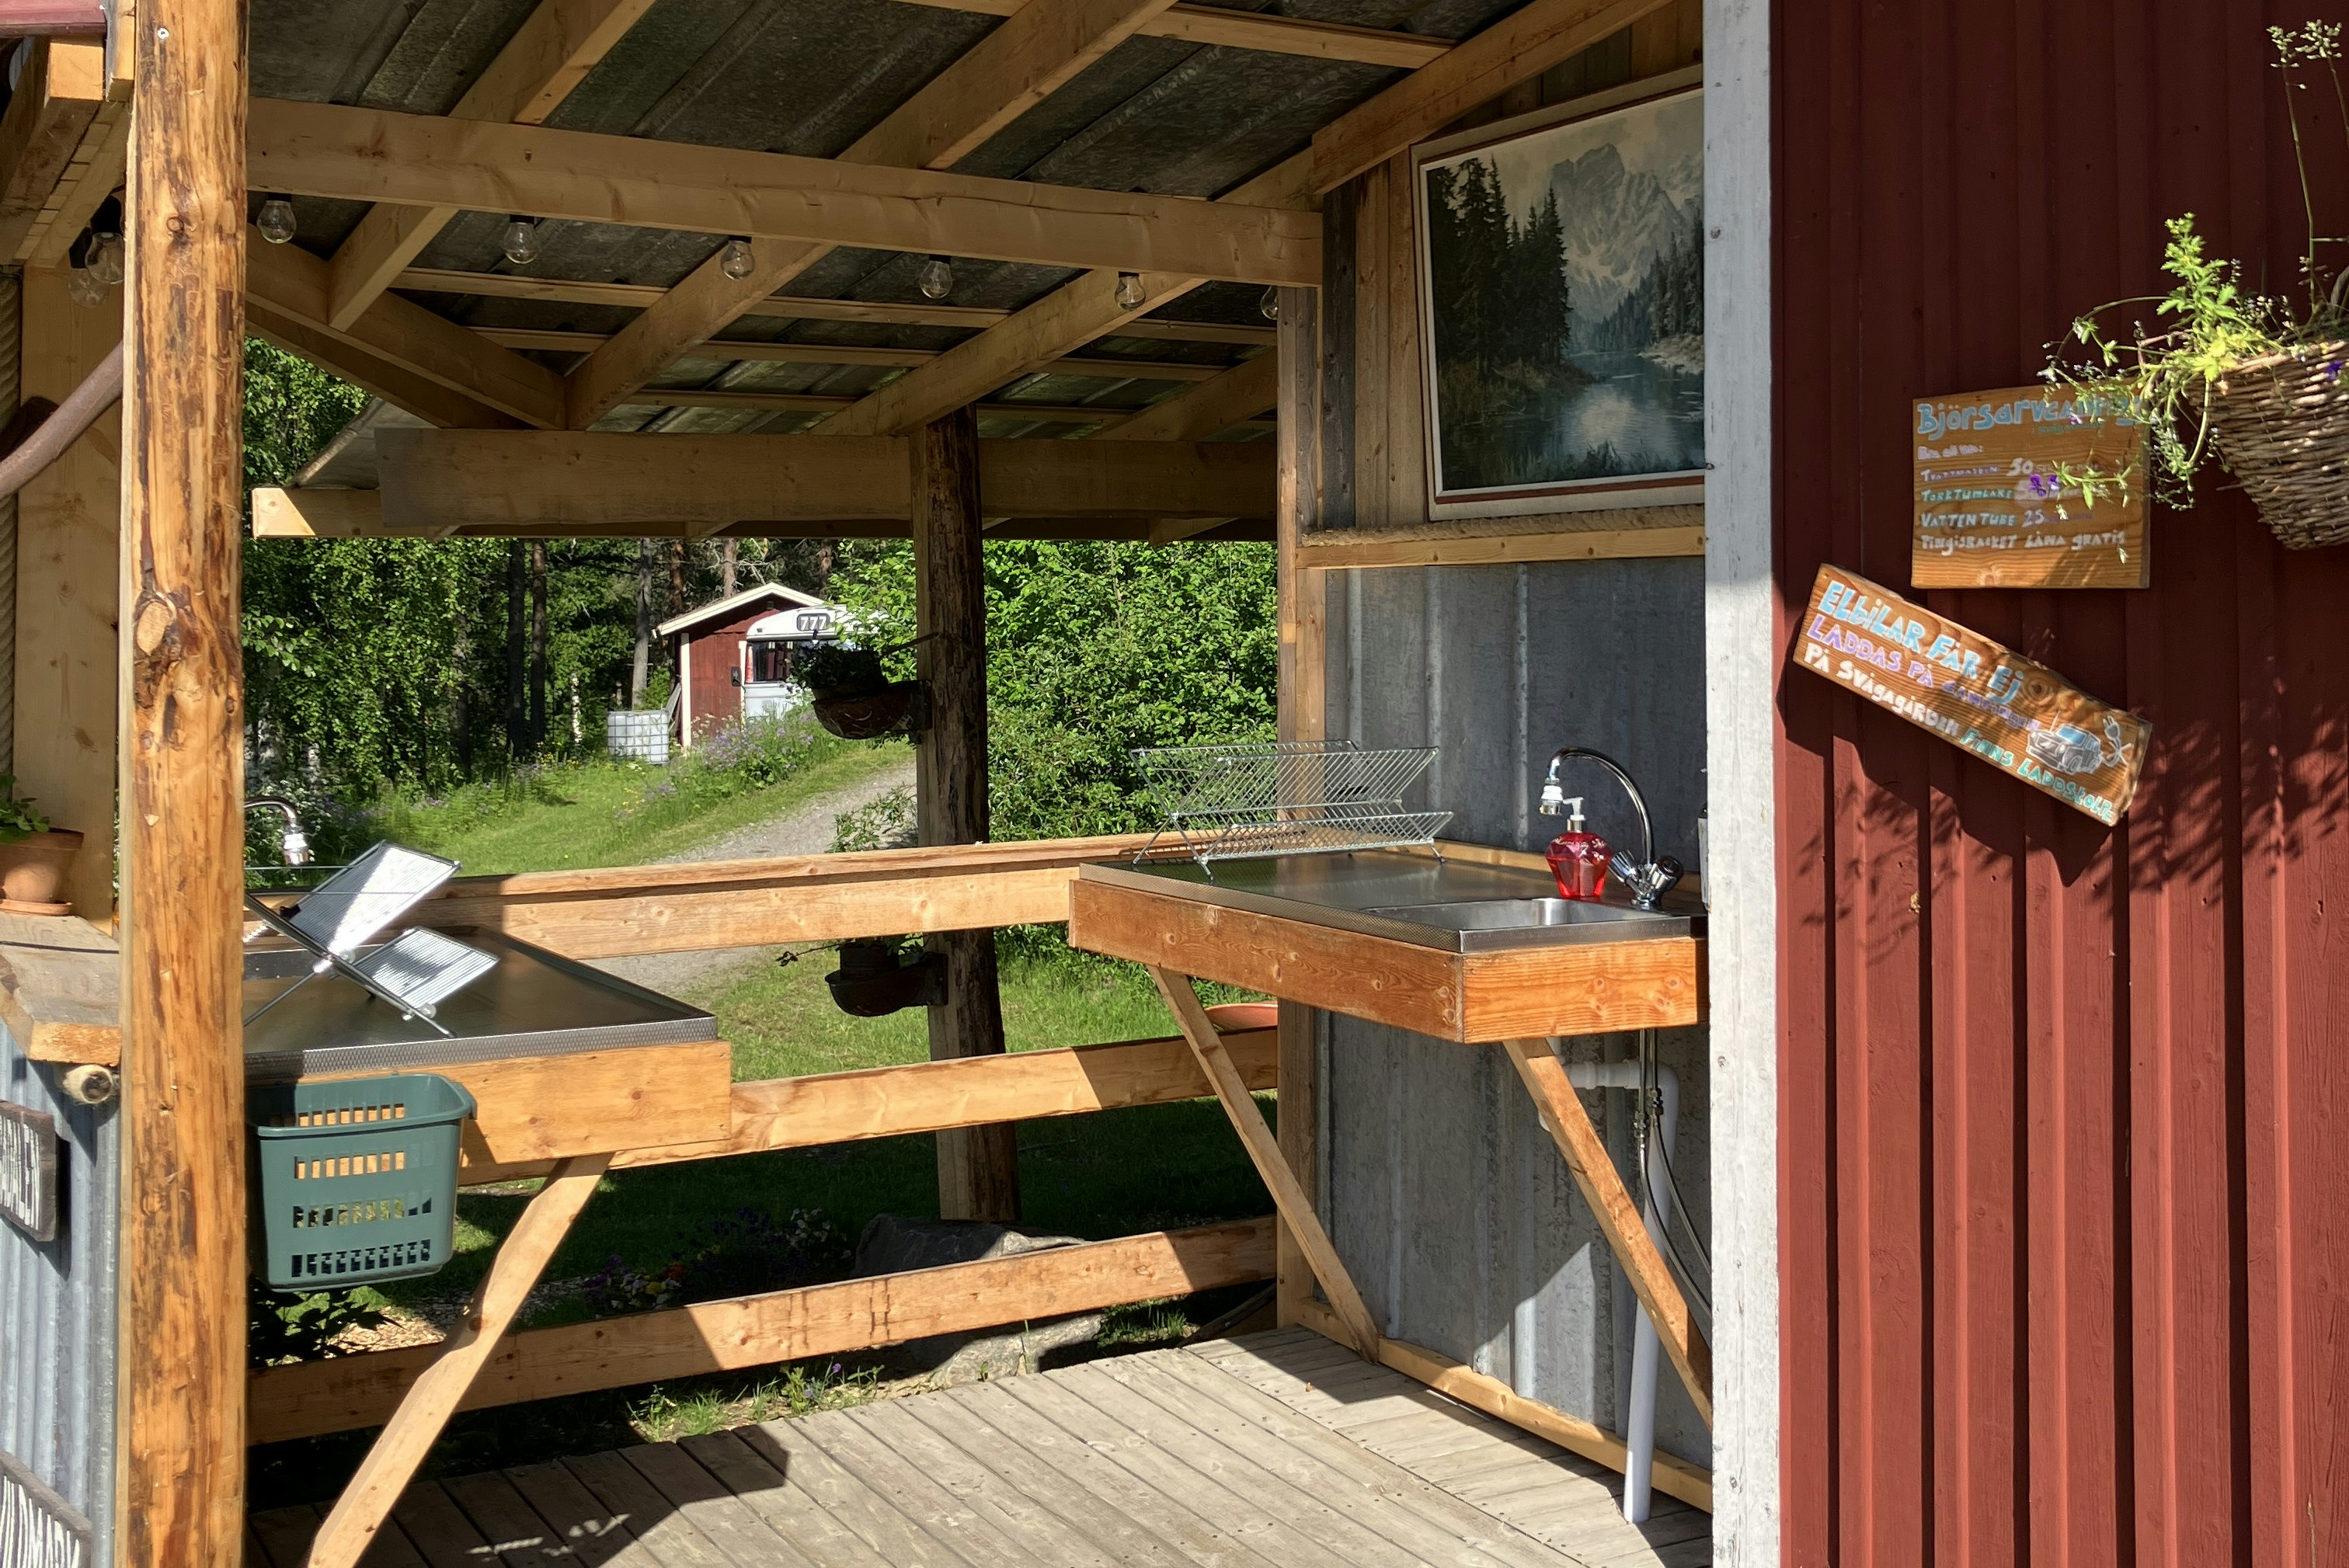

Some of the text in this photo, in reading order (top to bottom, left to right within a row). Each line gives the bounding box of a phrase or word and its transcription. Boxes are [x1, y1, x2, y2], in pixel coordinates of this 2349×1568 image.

[2022, 509, 2044, 527] 25
[801, 616, 827, 630] 777
[1804, 642, 1829, 673] PÅ
[1806, 614, 1902, 672] LADDAS
[1907, 660, 1933, 688] PÅ
[1925, 634, 1981, 680] FÅR
